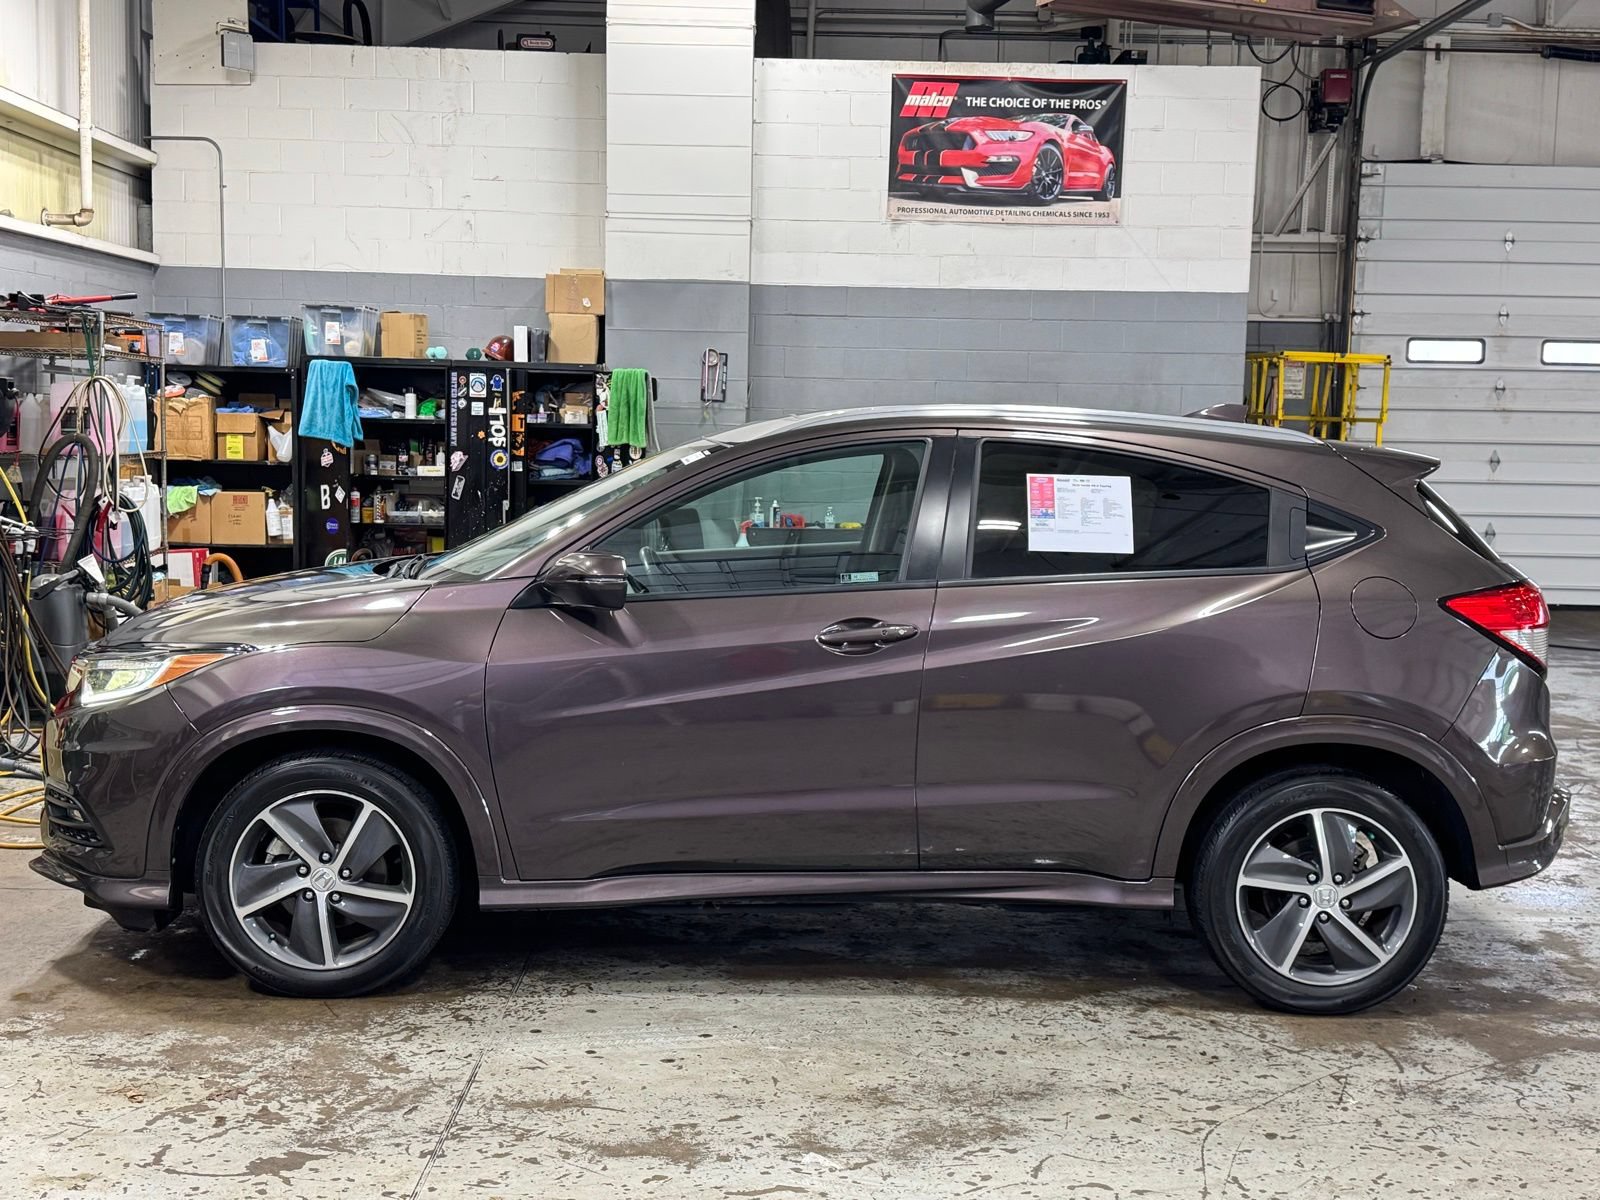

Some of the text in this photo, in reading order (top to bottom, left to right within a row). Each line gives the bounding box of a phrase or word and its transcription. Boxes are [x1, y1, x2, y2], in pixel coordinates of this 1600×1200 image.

[904, 92, 954, 107] malco
[965, 96, 987, 107] THE
[988, 97, 1030, 108] CHOICE
[1032, 98, 1048, 109] OF
[1048, 98, 1071, 109] THE
[896, 206, 1110, 219] PROFESSIONAL AUTOMOTIVE DETAILING CHEMICALS SINCE 1953
[320, 484, 331, 510] B
